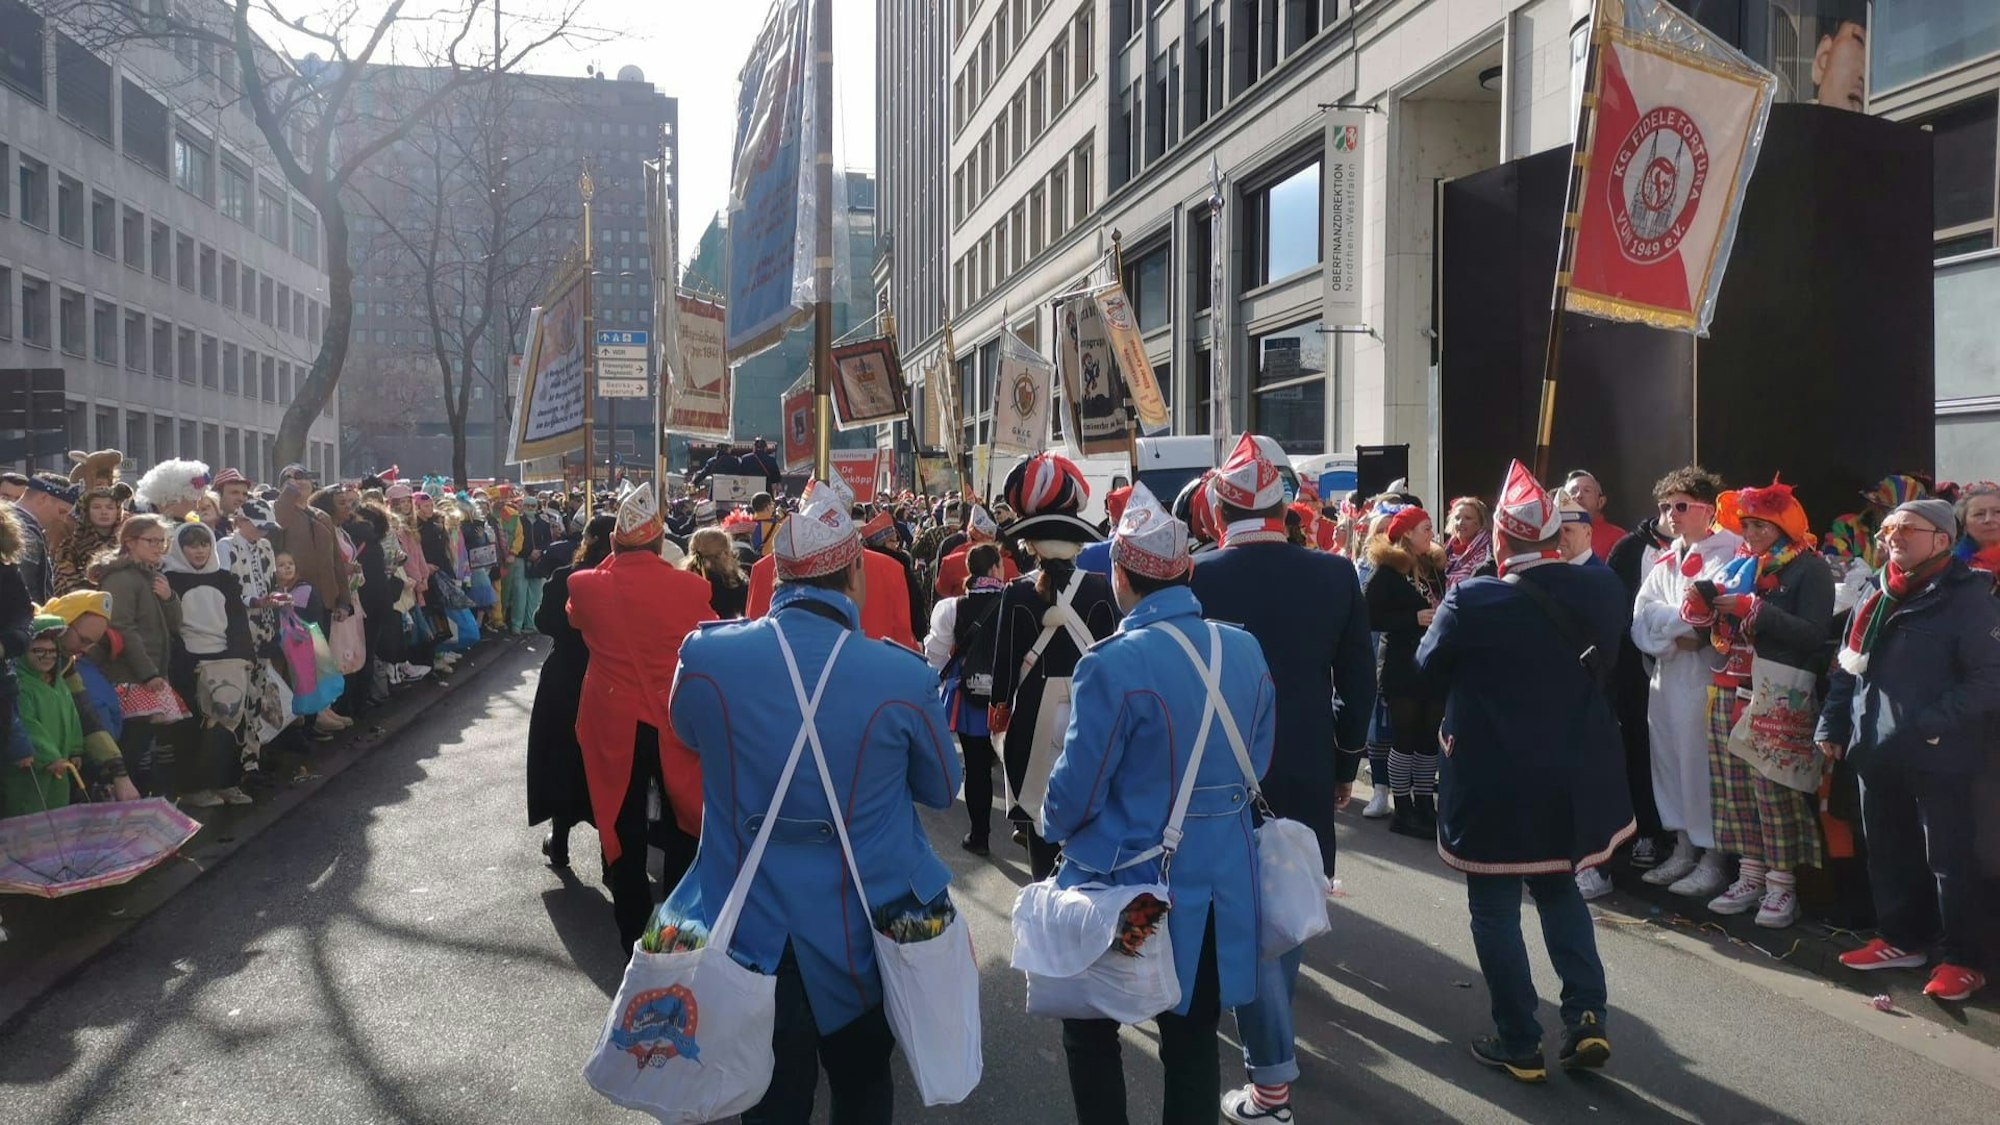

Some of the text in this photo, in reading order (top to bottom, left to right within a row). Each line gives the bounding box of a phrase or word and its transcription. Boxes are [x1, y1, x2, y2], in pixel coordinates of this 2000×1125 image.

[1613, 110, 1708, 202] KG FIDELE FORTUNA
[1331, 163, 1344, 292] OBERFINANZDIREKTION
[1344, 163, 1356, 292] Nordrhein-Westfalen
[1630, 241, 1661, 257] 1949
[1664, 223, 1686, 249] e.V.
[841, 465, 853, 473] De
